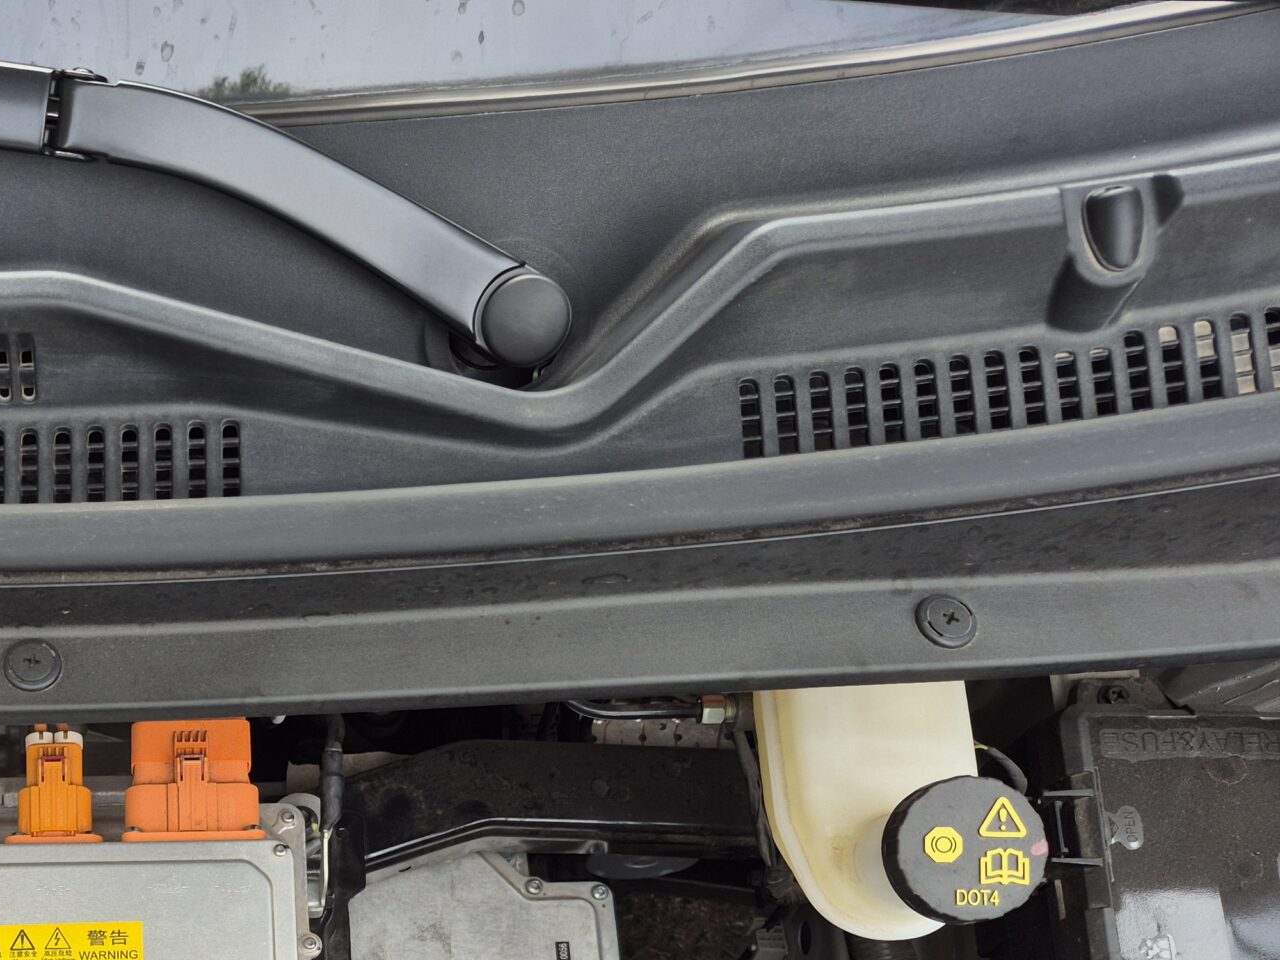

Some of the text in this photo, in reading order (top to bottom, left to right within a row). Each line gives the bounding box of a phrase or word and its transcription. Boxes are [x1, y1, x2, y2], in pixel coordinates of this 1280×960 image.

[1124, 811, 1138, 843] OPEN
[955, 889, 1000, 906] DOT4
[86, 929, 129, 947] 警告
[79, 950, 138, 960] WARNING
